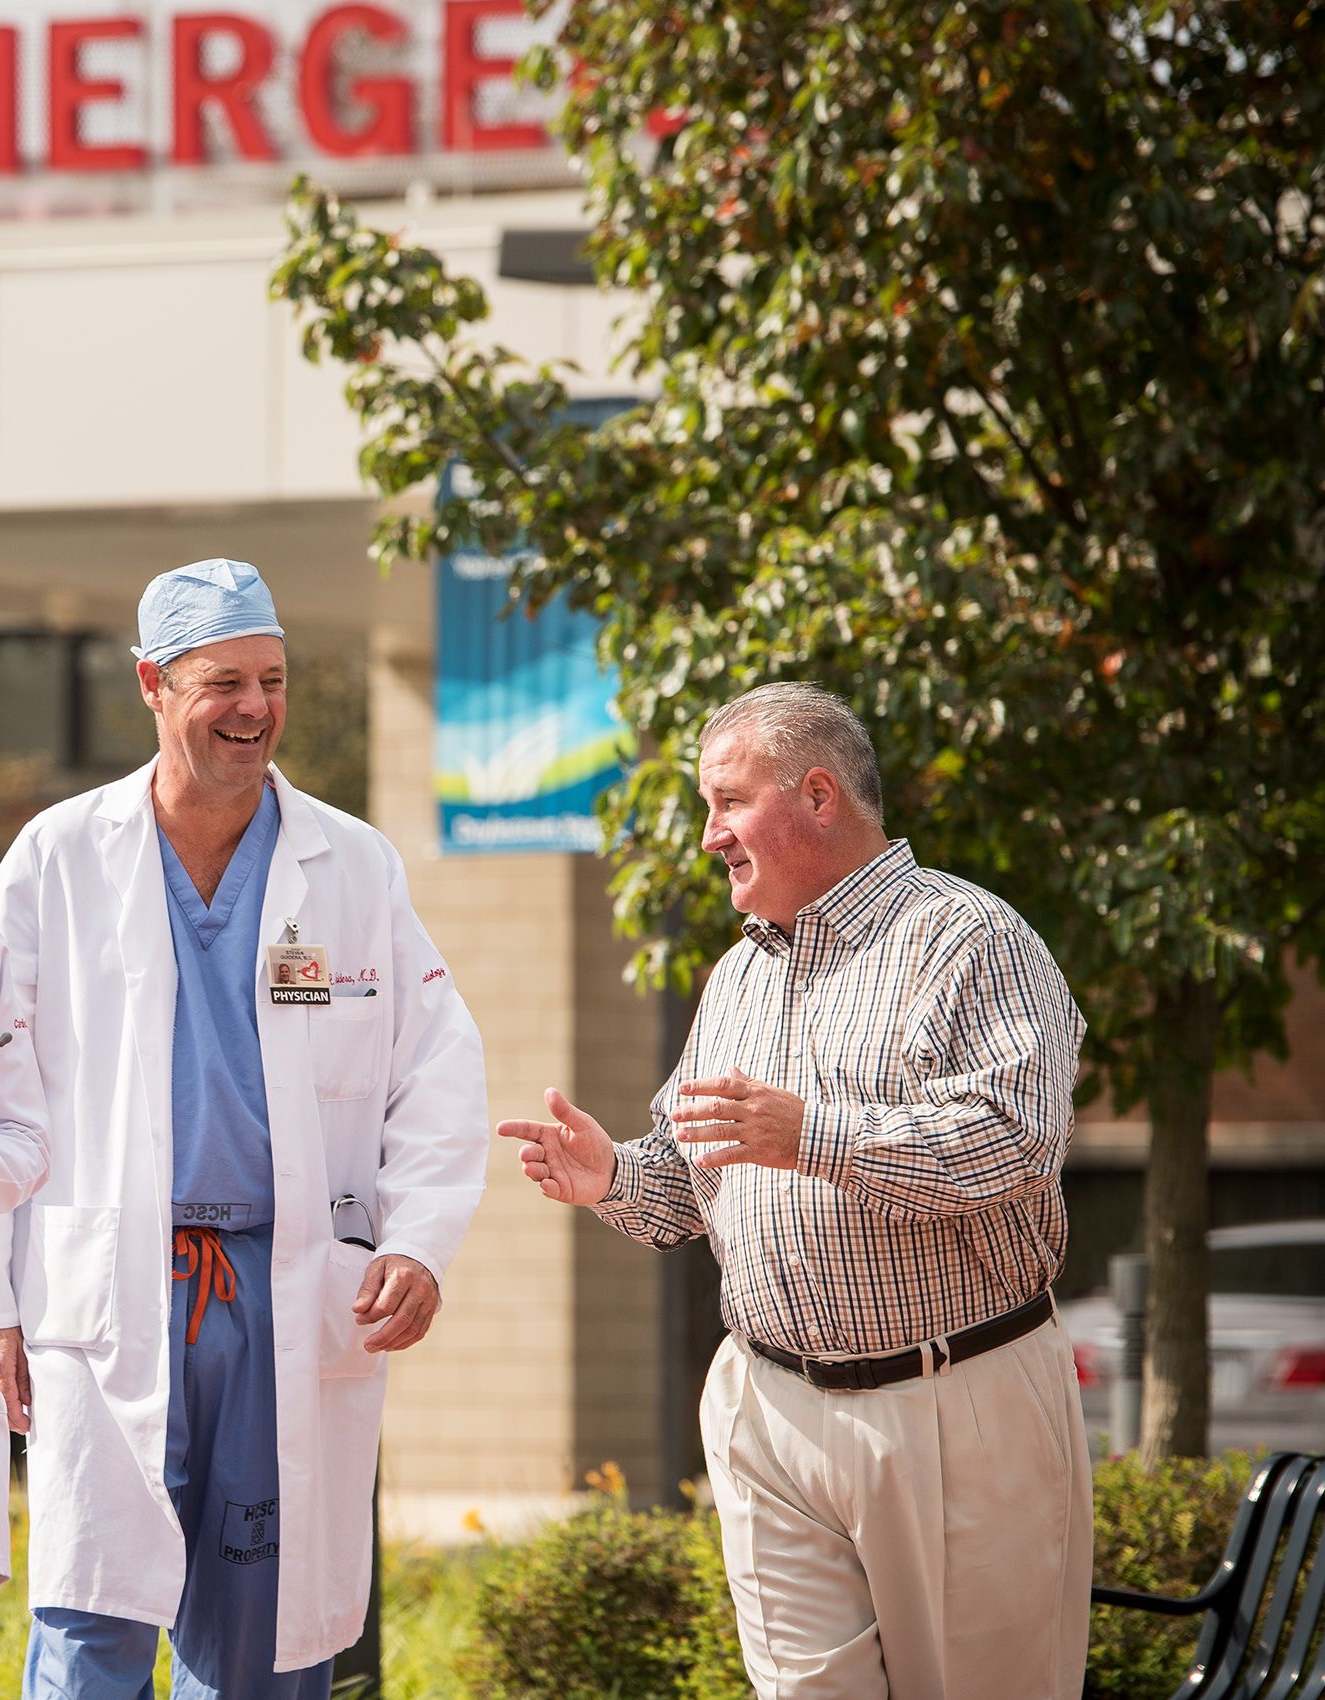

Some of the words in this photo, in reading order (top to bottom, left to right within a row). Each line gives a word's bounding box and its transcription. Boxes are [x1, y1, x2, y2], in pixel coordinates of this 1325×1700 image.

[273, 990, 329, 1002] PHYSICIAN
[244, 1501, 276, 1522] HCSC
[223, 1542, 280, 1562] PROPERTY
